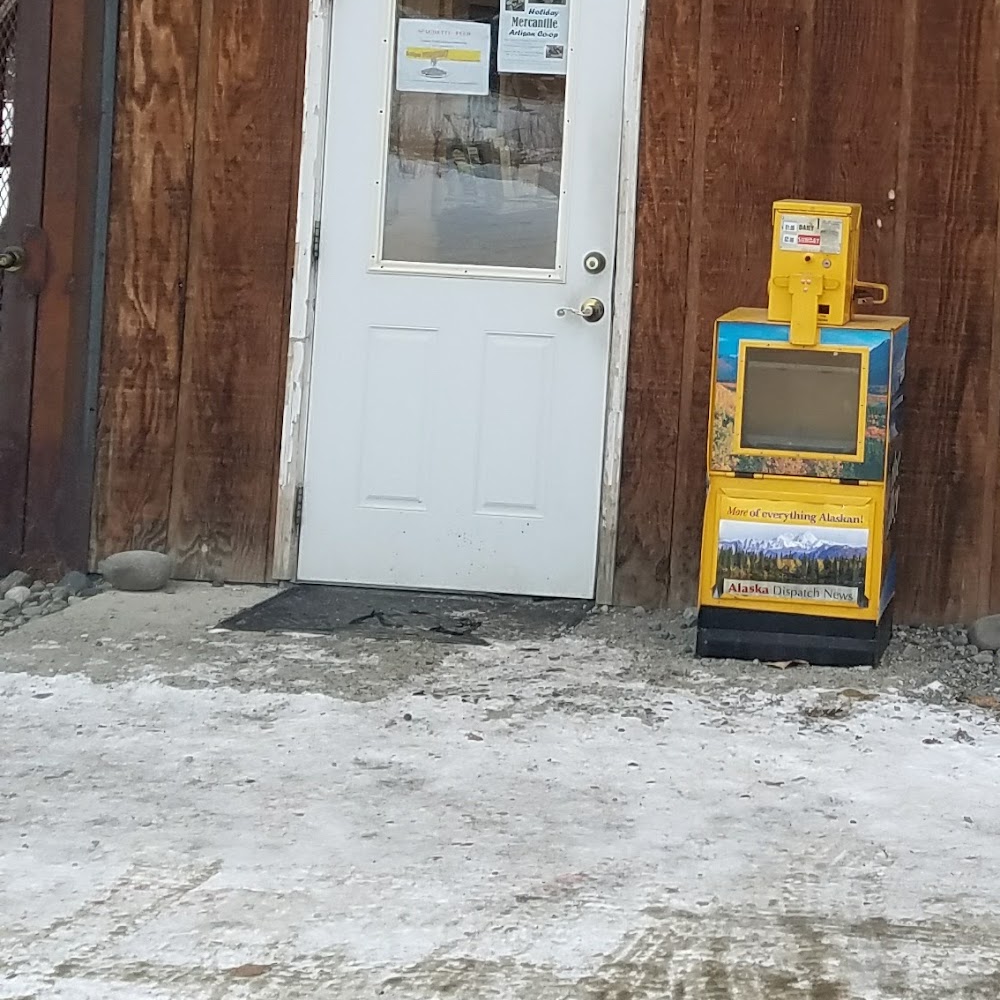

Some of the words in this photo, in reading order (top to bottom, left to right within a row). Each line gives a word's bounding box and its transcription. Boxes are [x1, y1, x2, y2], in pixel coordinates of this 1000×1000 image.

[528, 8, 559, 17] Holiday
[511, 16, 558, 29] Mercantile
[727, 506, 748, 516] More
[749, 508, 760, 517] of
[761, 510, 816, 523] everything
[819, 512, 863, 524] Alaskan!
[728, 583, 769, 595] Alaska
[773, 585, 820, 598] Dispatch
[823, 588, 854, 601] News
